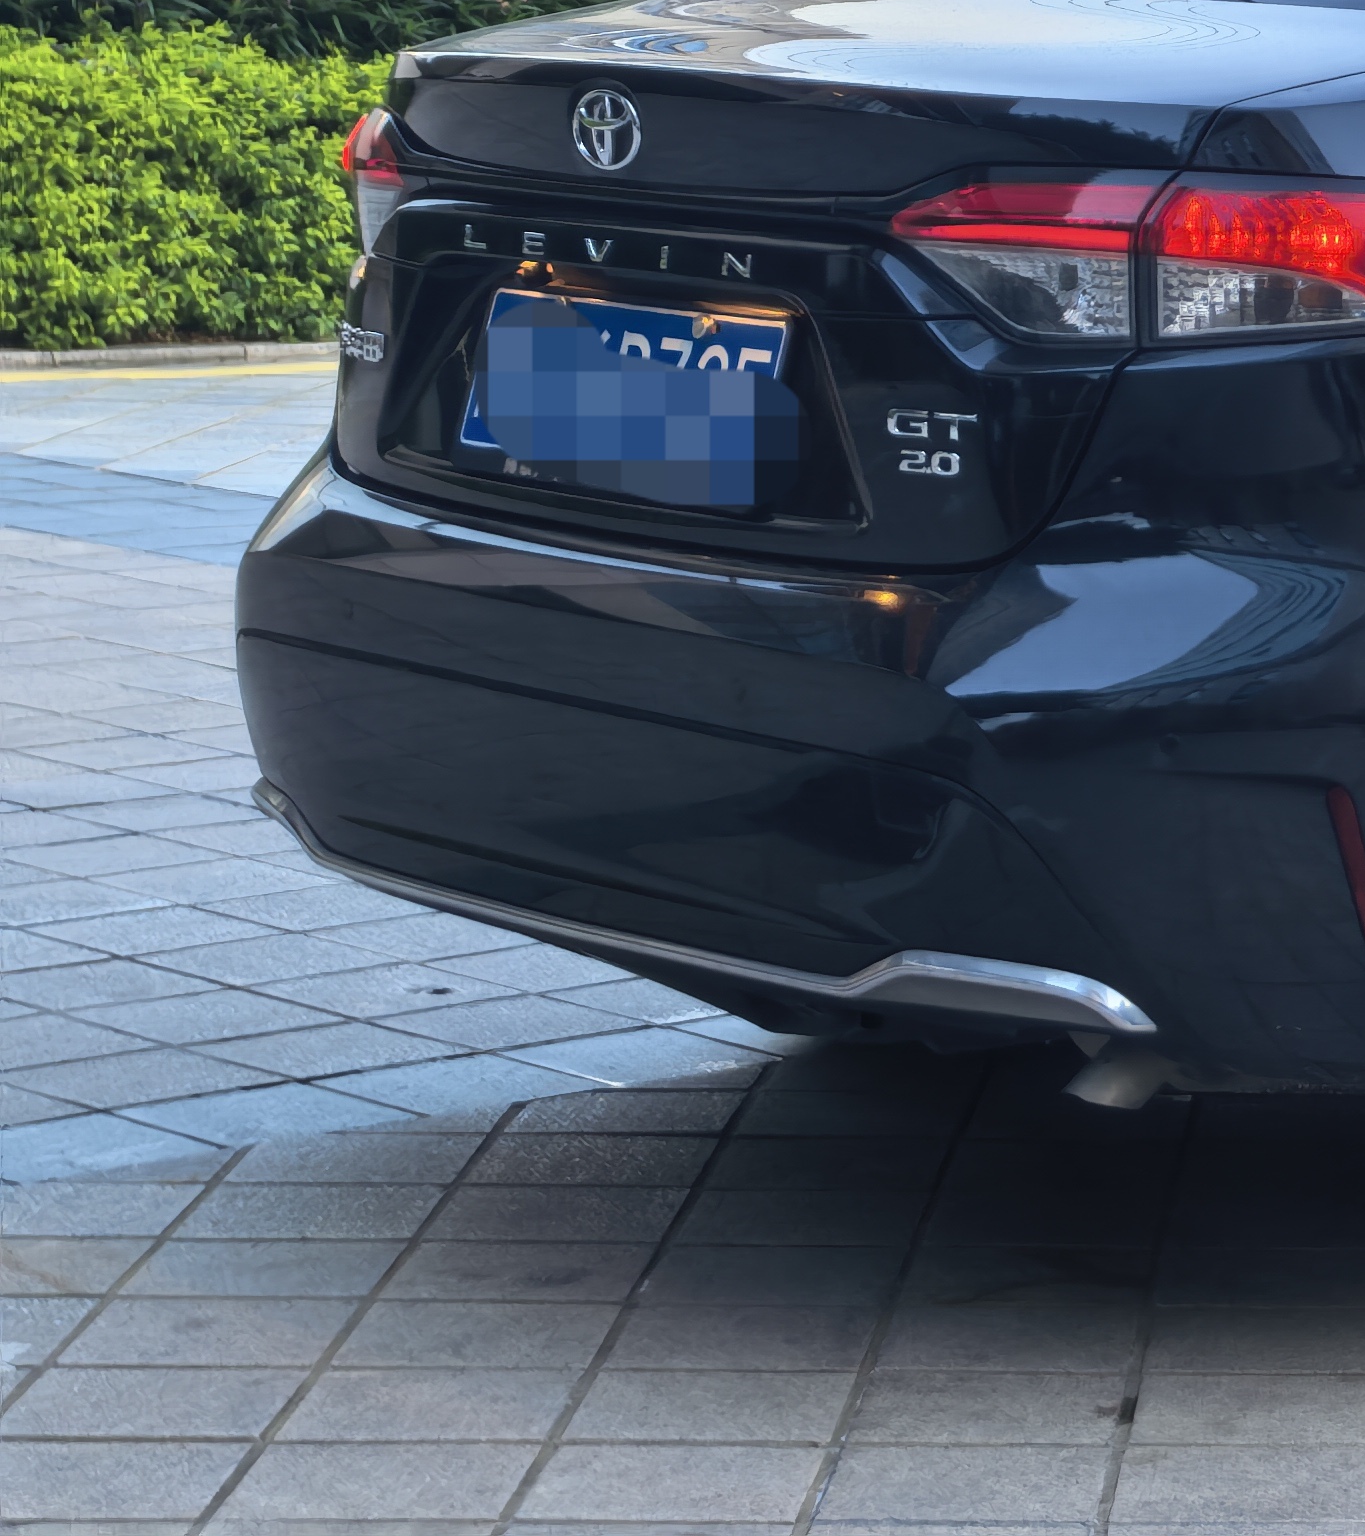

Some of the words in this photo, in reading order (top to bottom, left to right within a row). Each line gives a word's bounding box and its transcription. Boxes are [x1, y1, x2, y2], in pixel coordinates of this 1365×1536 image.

[463, 224, 752, 279] LEVIN
[887, 408, 978, 441] GT
[899, 449, 960, 476] 2.0
